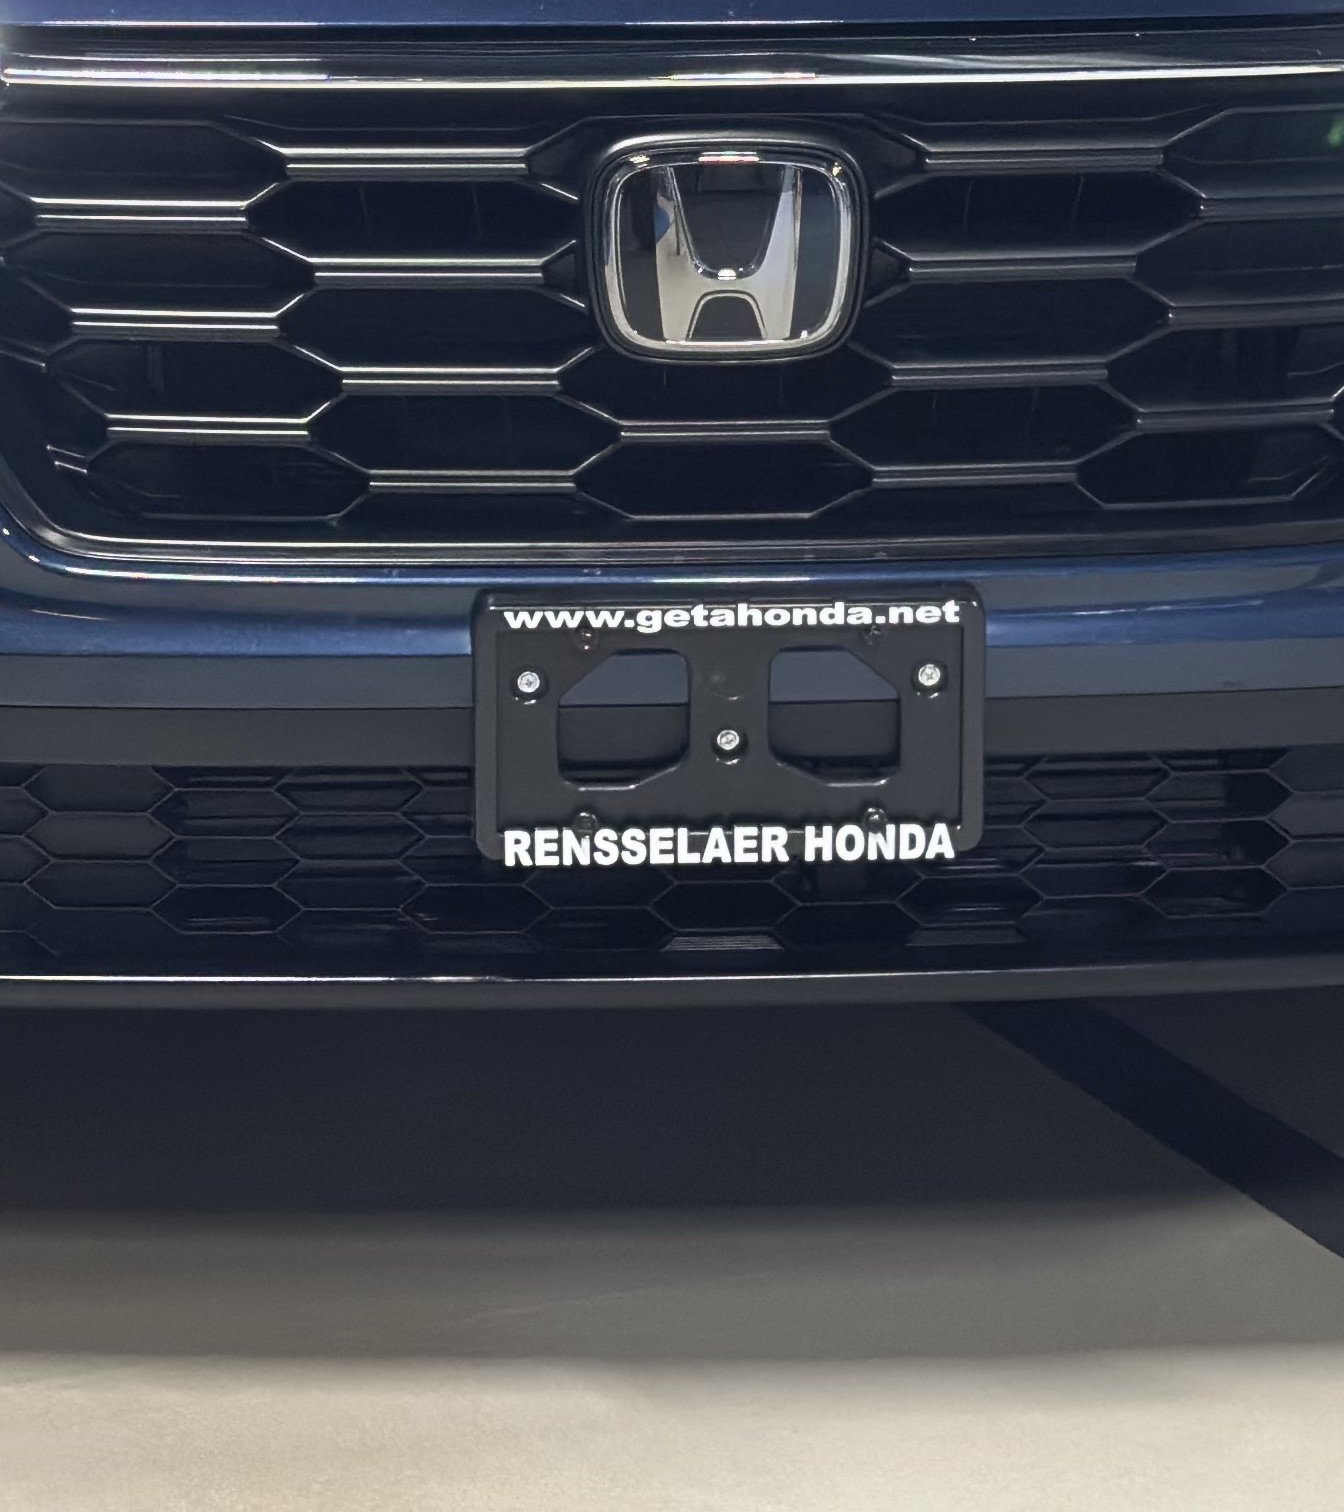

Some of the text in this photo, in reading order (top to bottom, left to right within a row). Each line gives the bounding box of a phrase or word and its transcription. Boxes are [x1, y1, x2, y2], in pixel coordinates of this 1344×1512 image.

[504, 600, 960, 634] www.getahonda.net
[503, 822, 956, 867] RENSSELAER HONDA
